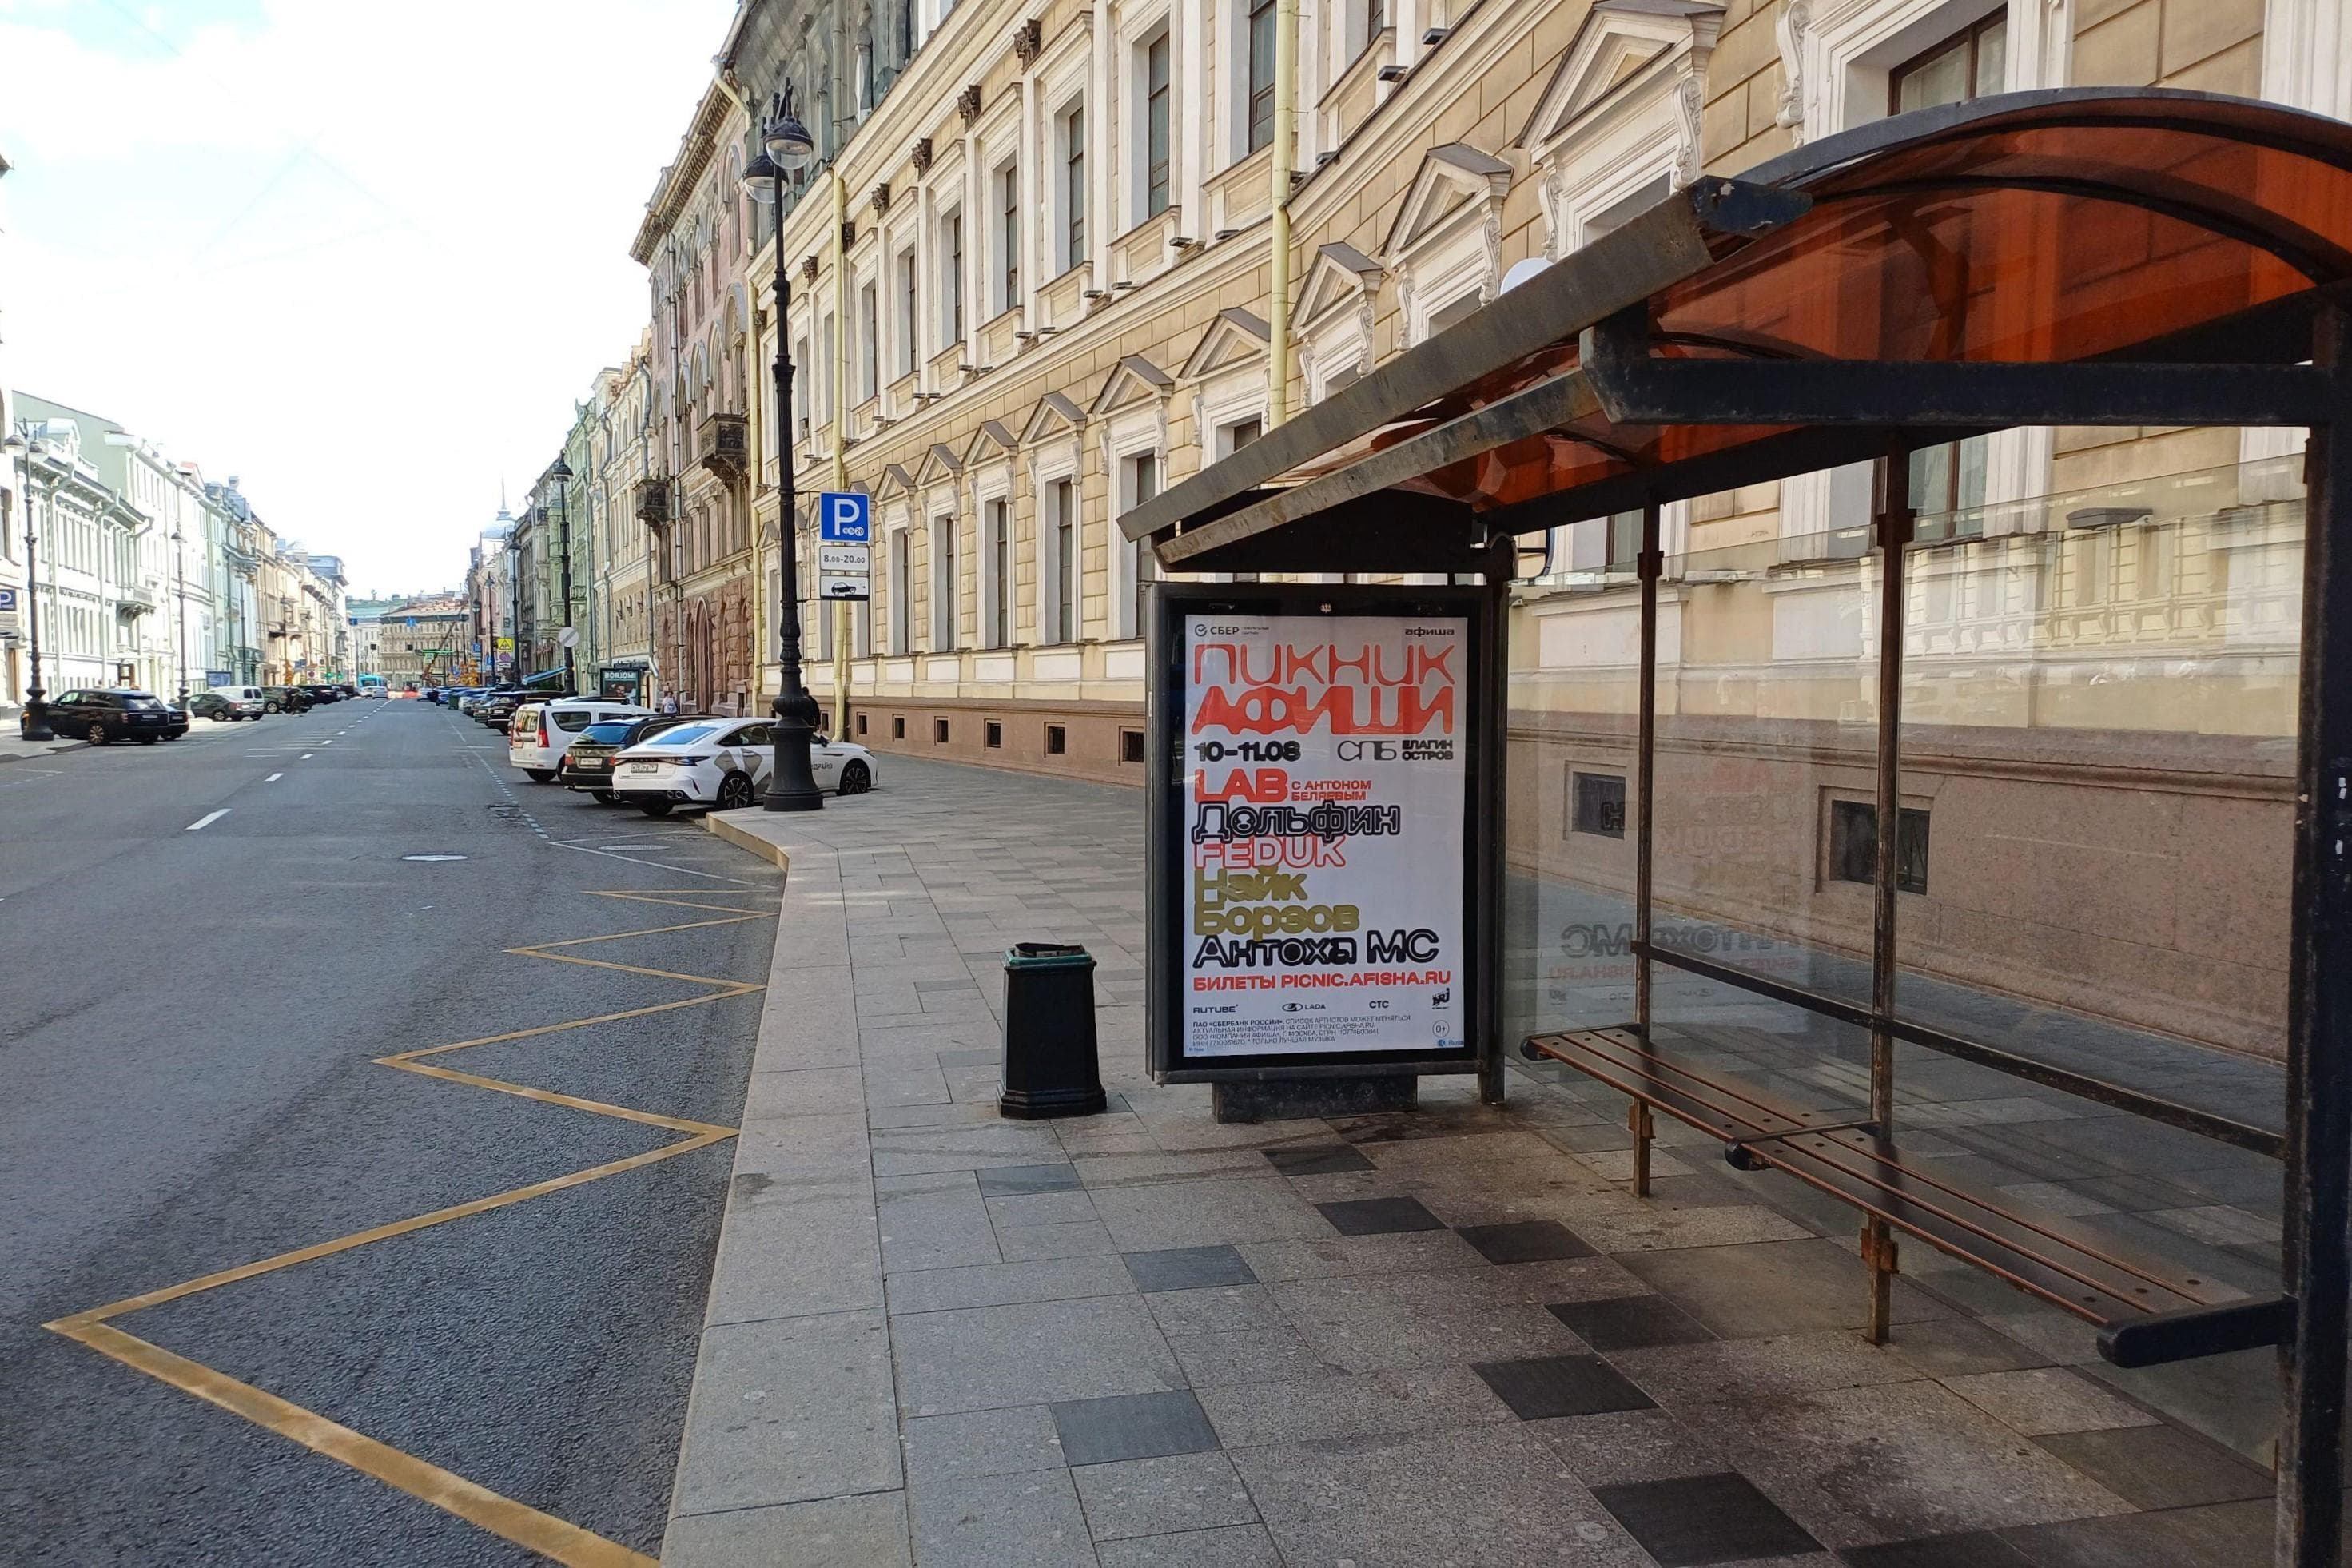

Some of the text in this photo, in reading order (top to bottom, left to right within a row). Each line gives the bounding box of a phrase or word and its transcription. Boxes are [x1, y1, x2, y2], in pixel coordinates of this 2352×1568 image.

[834, 499, 860, 535] P
[824, 555, 866, 563] 8.00-20.00
[1405, 627, 1455, 637] афиша
[1194, 644, 1455, 686] ПИКНИК
[1192, 686, 1454, 735] АФИШИ
[1338, 740, 1397, 761] СПБ
[1402, 740, 1453, 750] ЕЛАГИН
[1402, 751, 1453, 761] ОСТРОВ
[1194, 769, 1288, 803] LAB
[1291, 780, 1371, 790] С АНТОНОМ
[1291, 791, 1367, 801] БЕЛЯЕВЫМ
[1192, 800, 1400, 843] Дольфин
[1194, 834, 1347, 869] FEDUK
[1194, 903, 1360, 942] Борзов
[1193, 934, 1357, 968] Антоха
[1193, 970, 1451, 991] БИЛЕТЫ PICNIC.AFISHA.RU
